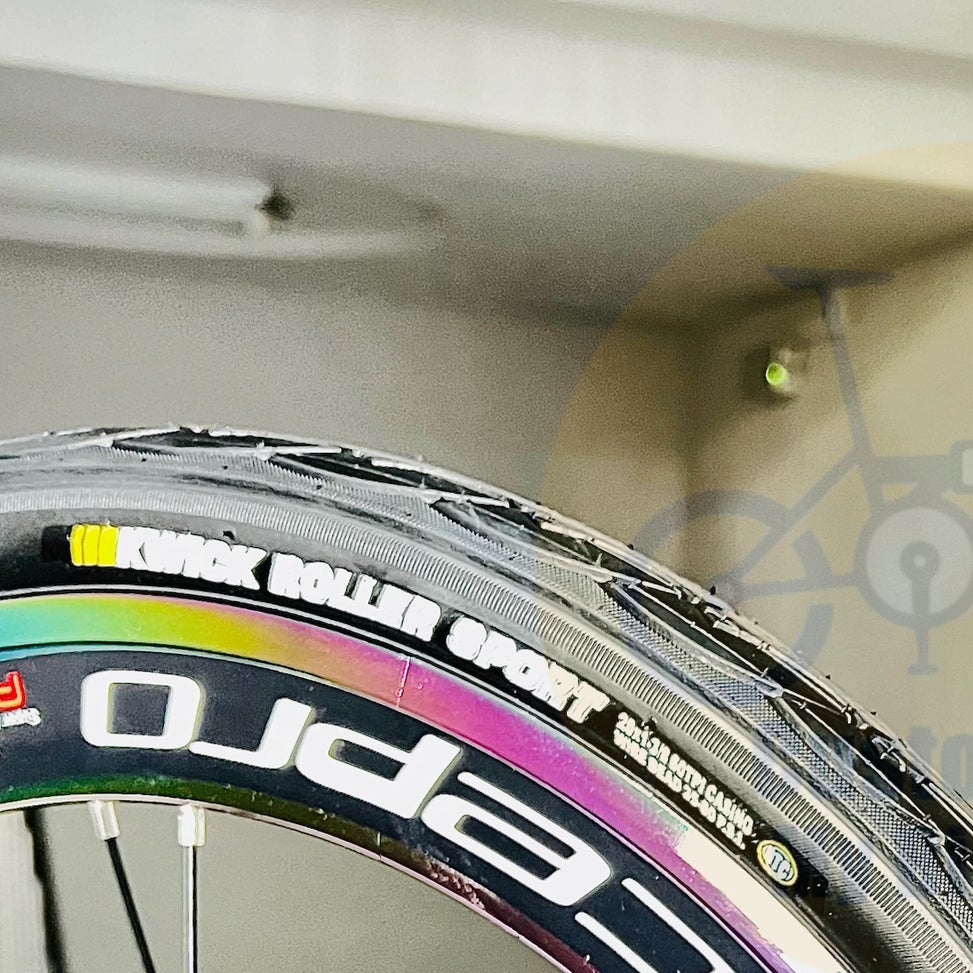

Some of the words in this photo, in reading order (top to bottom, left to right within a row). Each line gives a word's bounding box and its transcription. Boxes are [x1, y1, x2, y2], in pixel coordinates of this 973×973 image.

[116, 526, 267, 590] KWICK
[267, 552, 441, 641] ROLLER
[447, 616, 611, 724] SPORT
